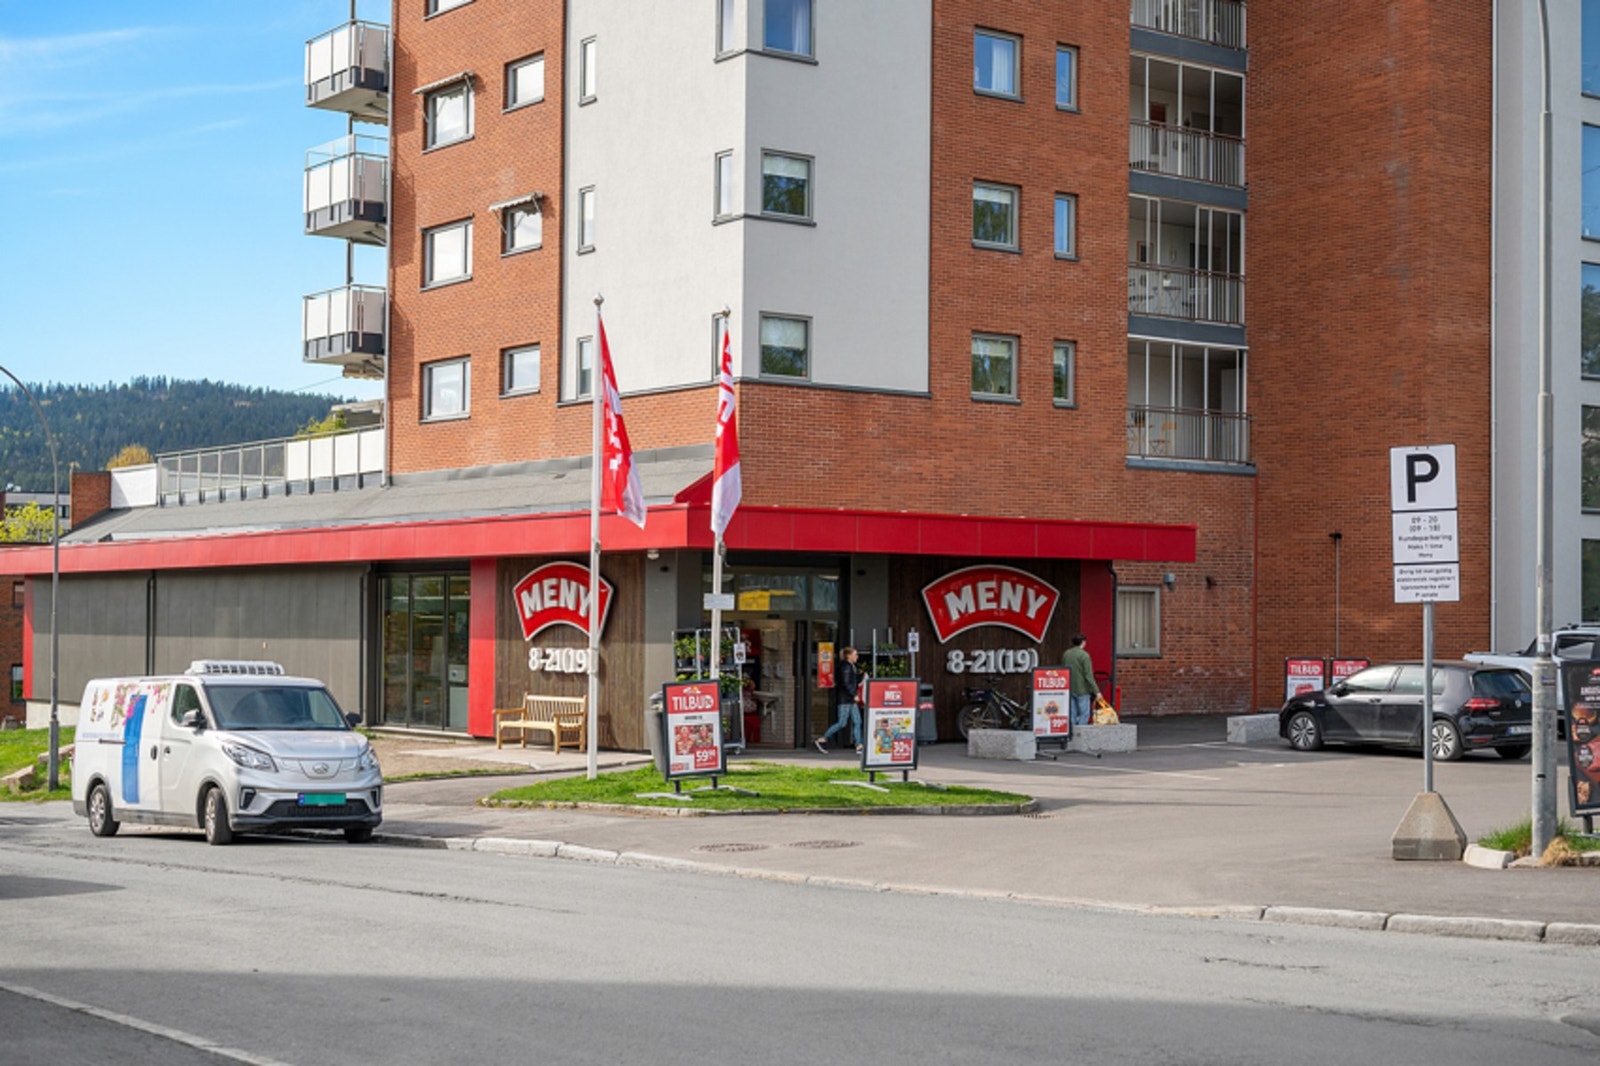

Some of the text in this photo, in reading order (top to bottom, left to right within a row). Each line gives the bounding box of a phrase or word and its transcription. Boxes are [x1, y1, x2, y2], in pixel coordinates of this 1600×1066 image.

[1406, 453, 1440, 503] P
[521, 578, 591, 620] MENY
[944, 580, 1048, 622] MENY
[947, 648, 1039, 674] 8-21(19)
[1290, 664, 1320, 676] TILBUD
[1037, 677, 1066, 689] TILBUD
[671, 694, 715, 711] TILBUD
